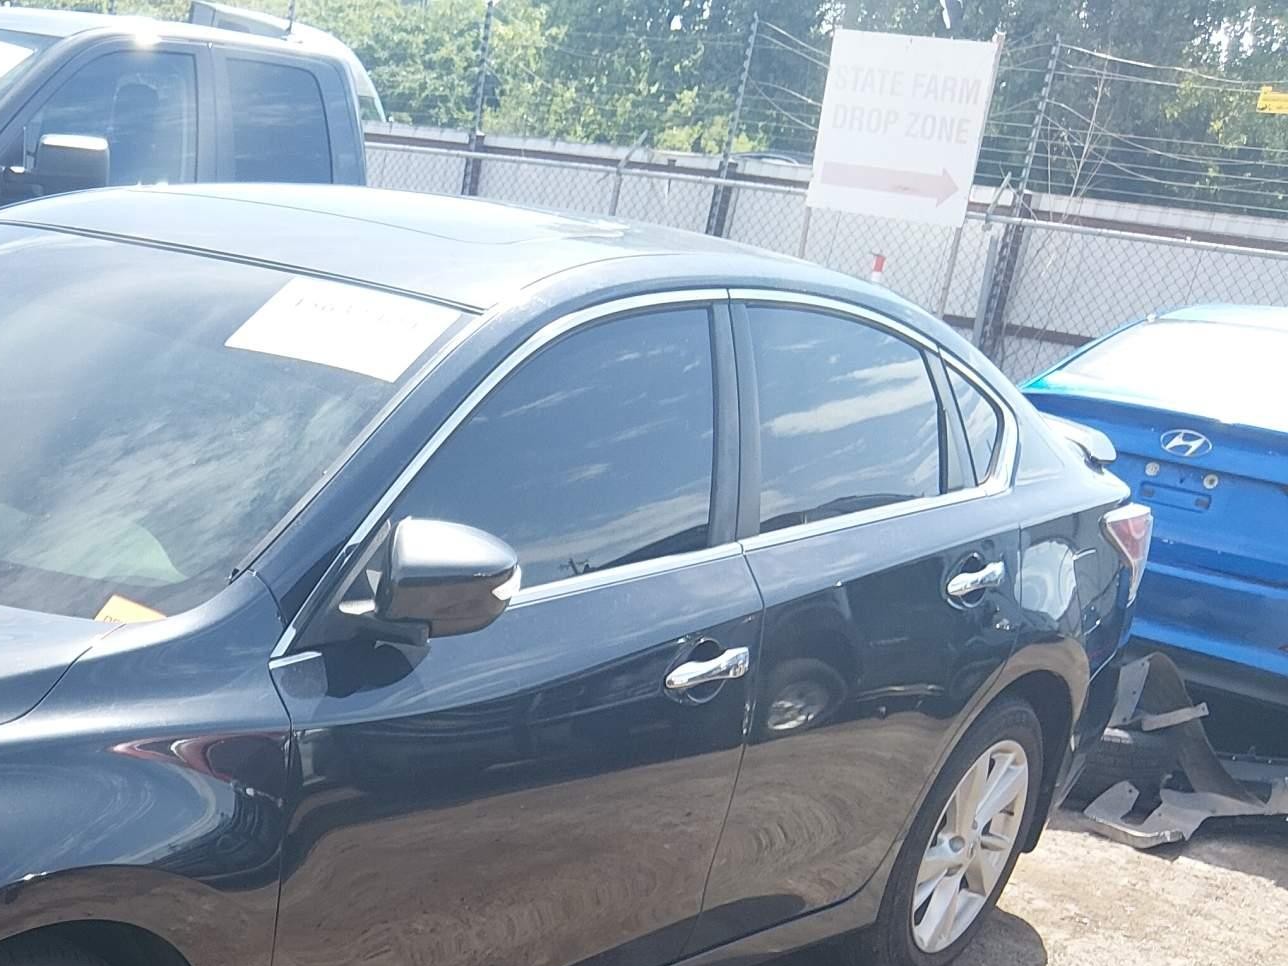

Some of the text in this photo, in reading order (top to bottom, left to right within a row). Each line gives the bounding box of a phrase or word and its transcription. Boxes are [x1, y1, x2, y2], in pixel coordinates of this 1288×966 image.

[834, 64, 983, 105] STATE FARM
[831, 103, 972, 144] DROP ZONE
